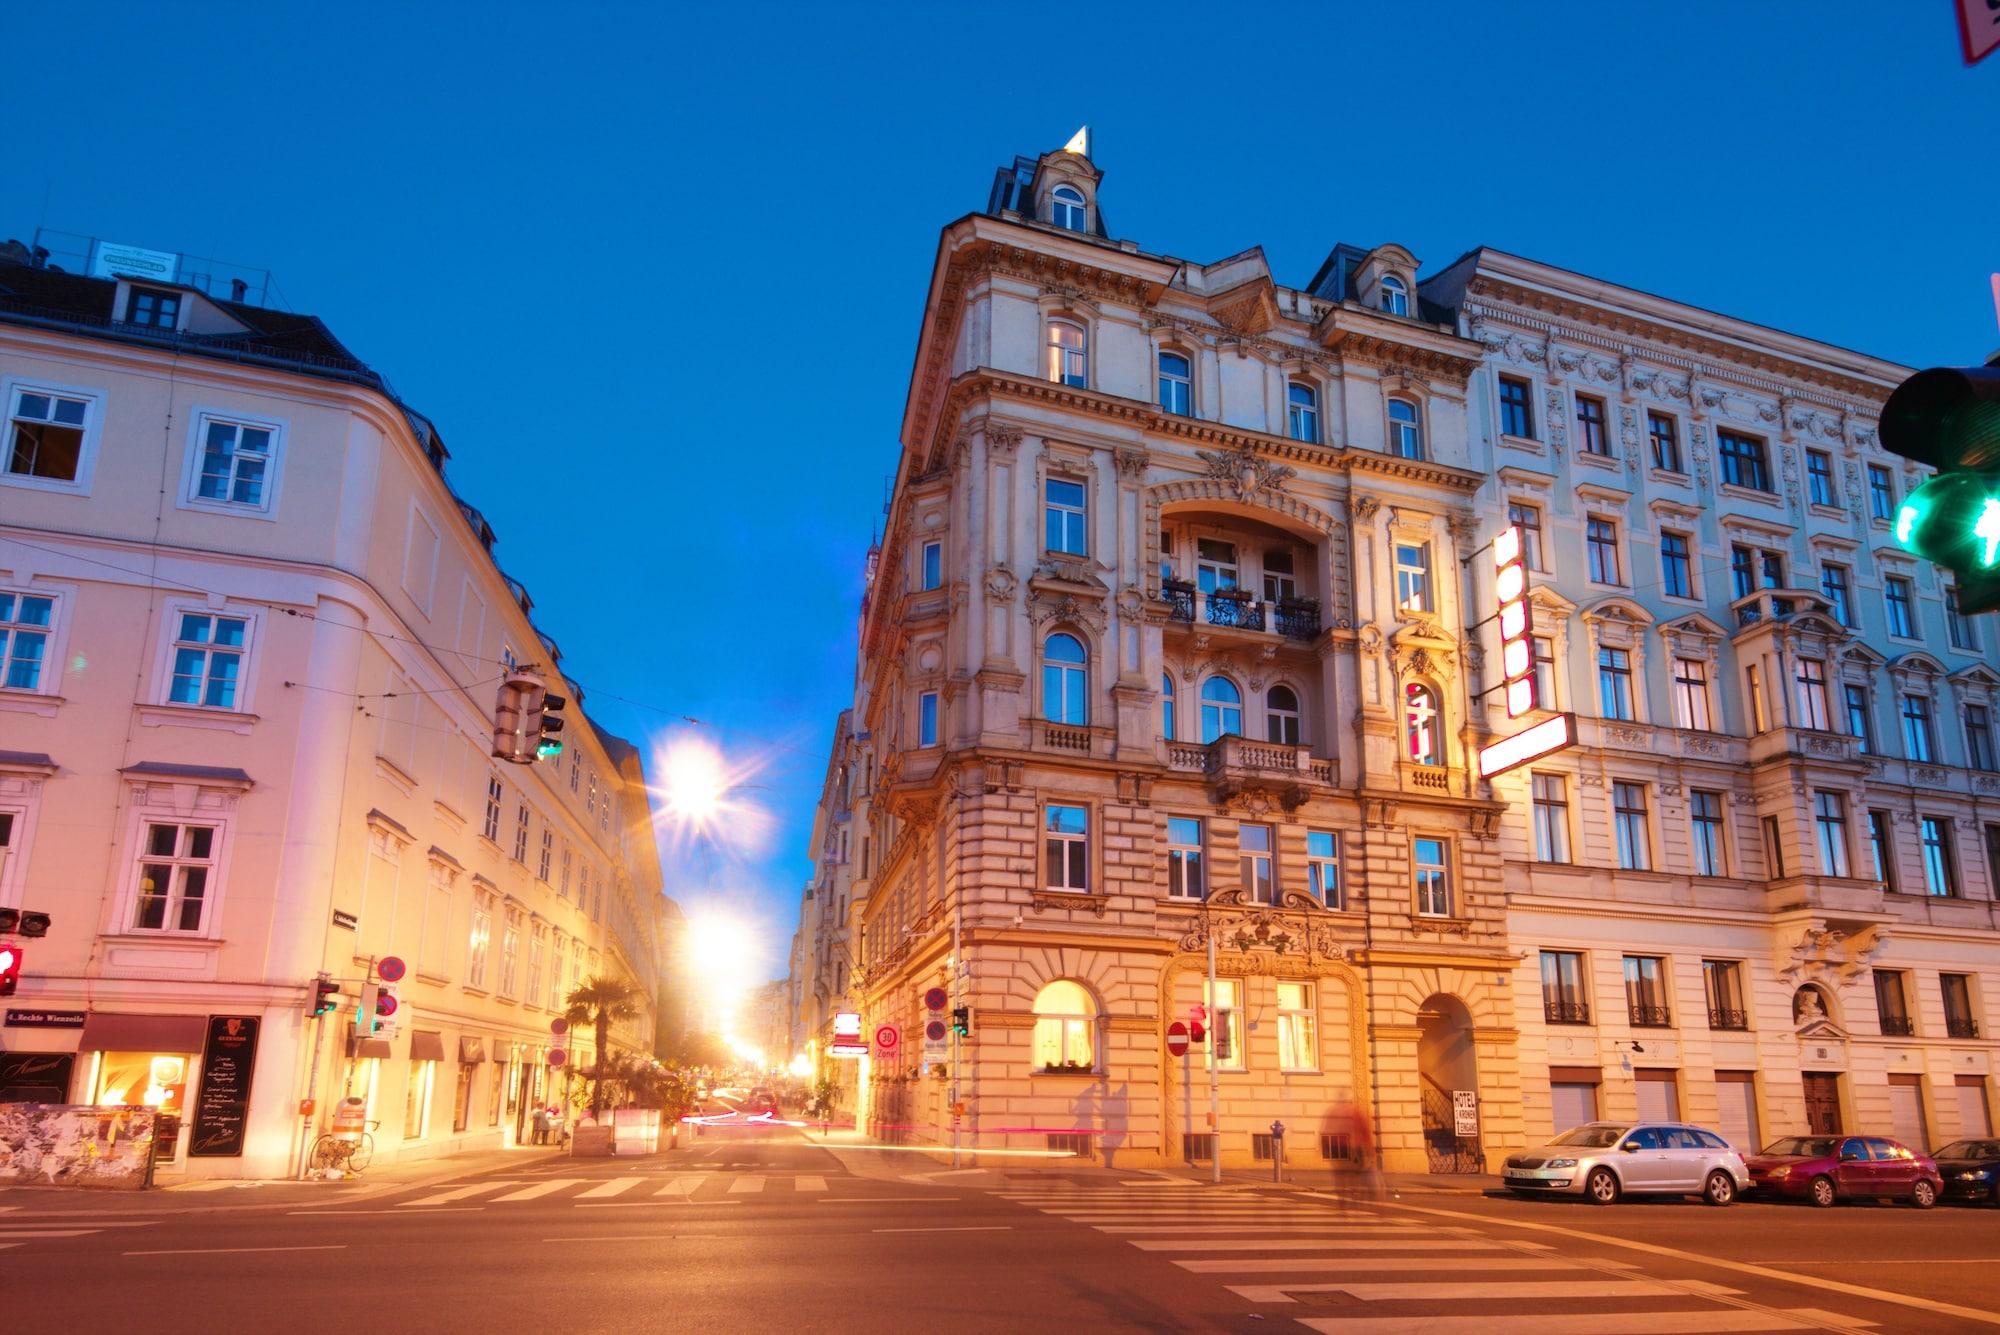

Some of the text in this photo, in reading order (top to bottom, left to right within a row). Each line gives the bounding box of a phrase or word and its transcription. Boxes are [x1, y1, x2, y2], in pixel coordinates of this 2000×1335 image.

[47, 1014, 84, 1023] Wienzeile
[882, 1032, 892, 1042] 30
[1454, 1092, 1475, 1108] HOTEL
